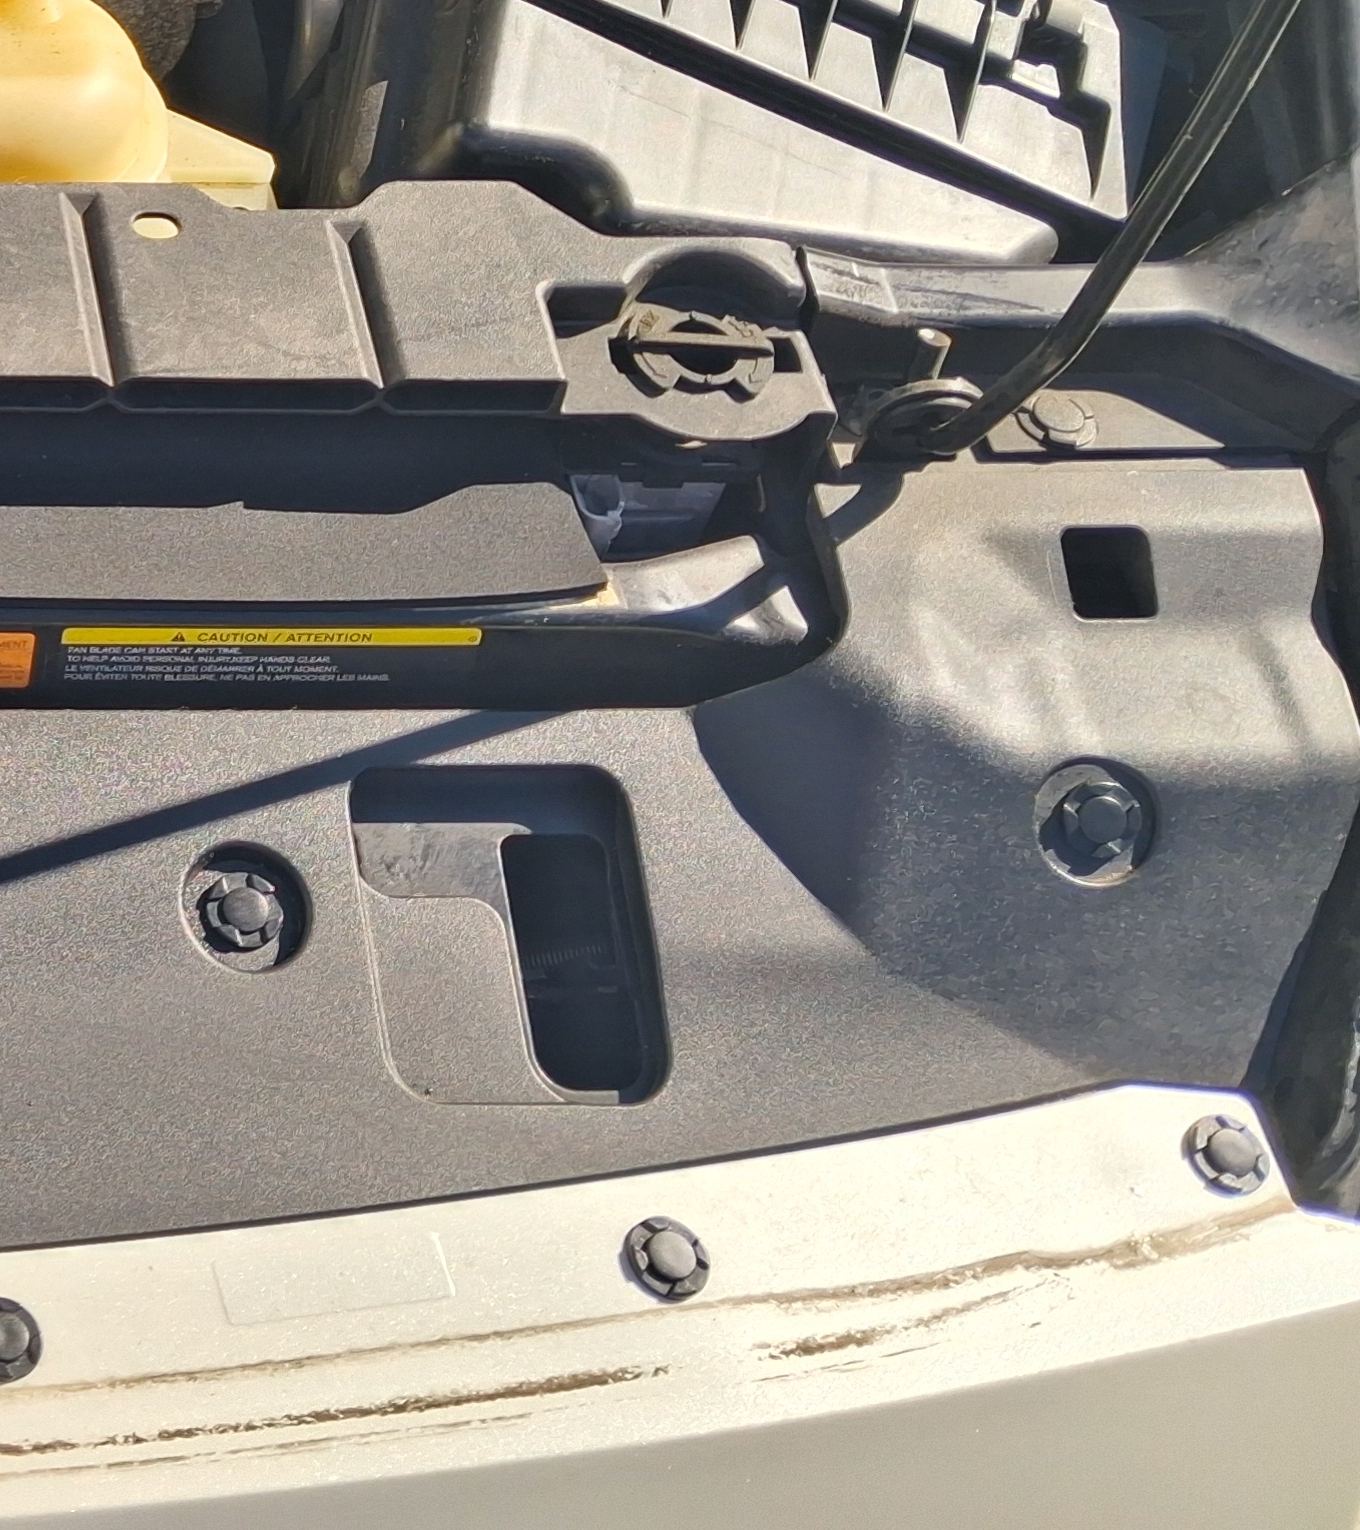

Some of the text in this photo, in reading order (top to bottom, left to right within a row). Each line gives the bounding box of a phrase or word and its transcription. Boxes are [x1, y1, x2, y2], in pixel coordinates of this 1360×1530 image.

[197, 632, 268, 643] CAUTION
[285, 632, 373, 643] ATTENTION
[67, 655, 80, 663] TO
[65, 665, 78, 673] LE
[184, 665, 199, 673] DE
[64, 673, 93, 682] POUR
[220, 673, 234, 682] NE
[236, 673, 256, 682] PAS
[258, 673, 272, 682] EN
